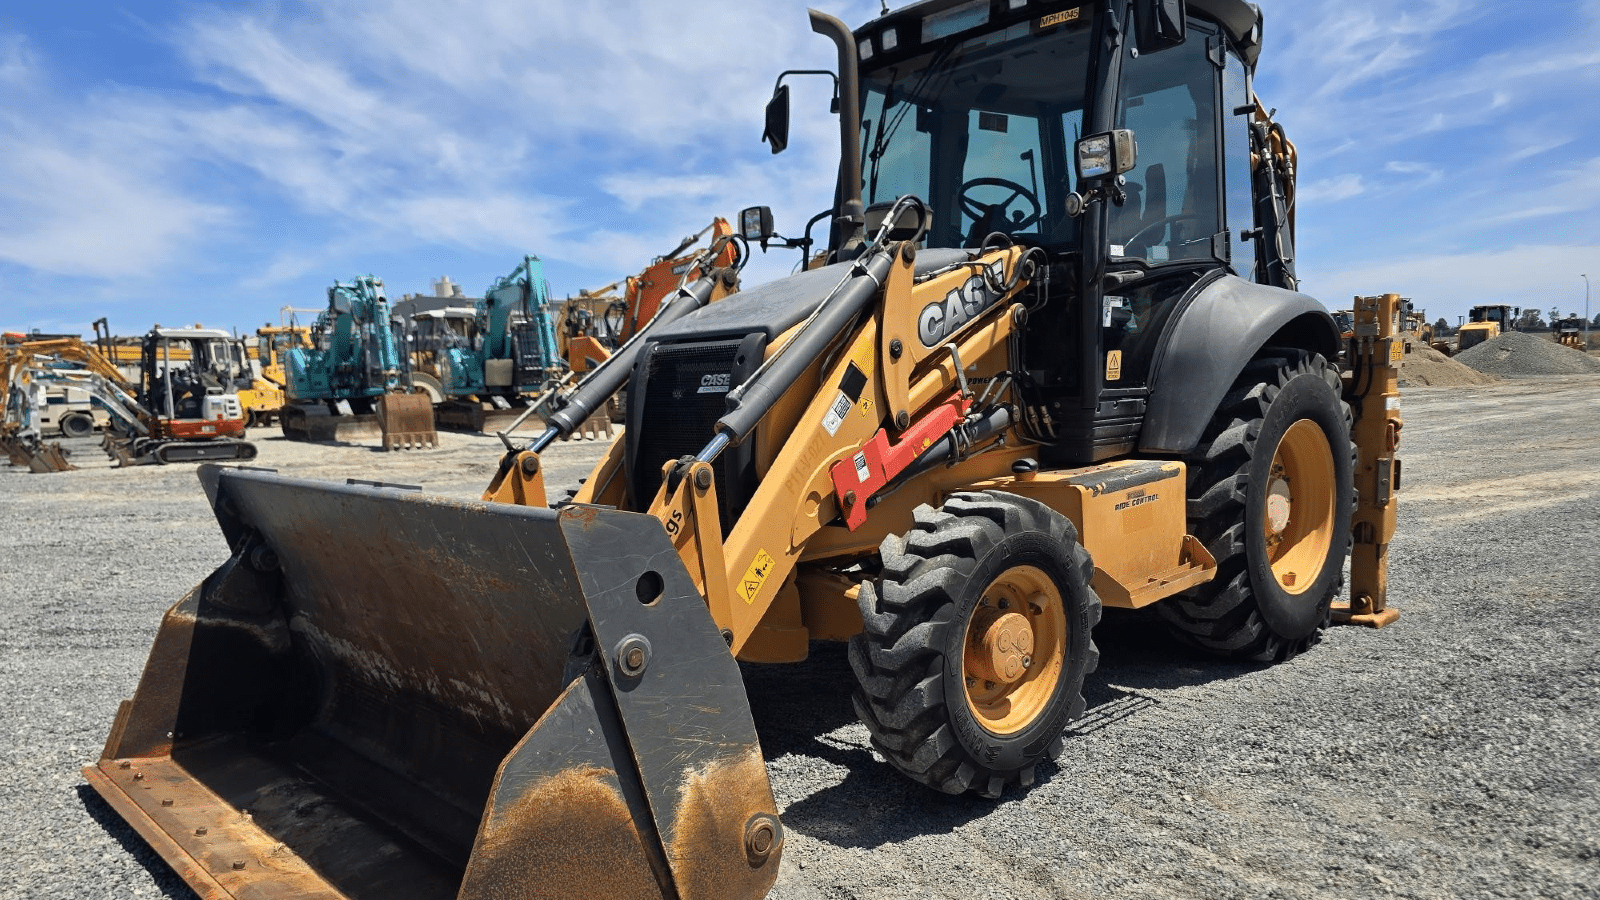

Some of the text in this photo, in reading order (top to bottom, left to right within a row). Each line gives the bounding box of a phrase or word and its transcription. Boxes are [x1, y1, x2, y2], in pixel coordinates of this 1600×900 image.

[1040, 9, 1079, 26] MPH1045
[701, 373, 730, 386] CASE
[1114, 501, 1130, 511] RIDE
[1131, 493, 1159, 507] CONTROL
